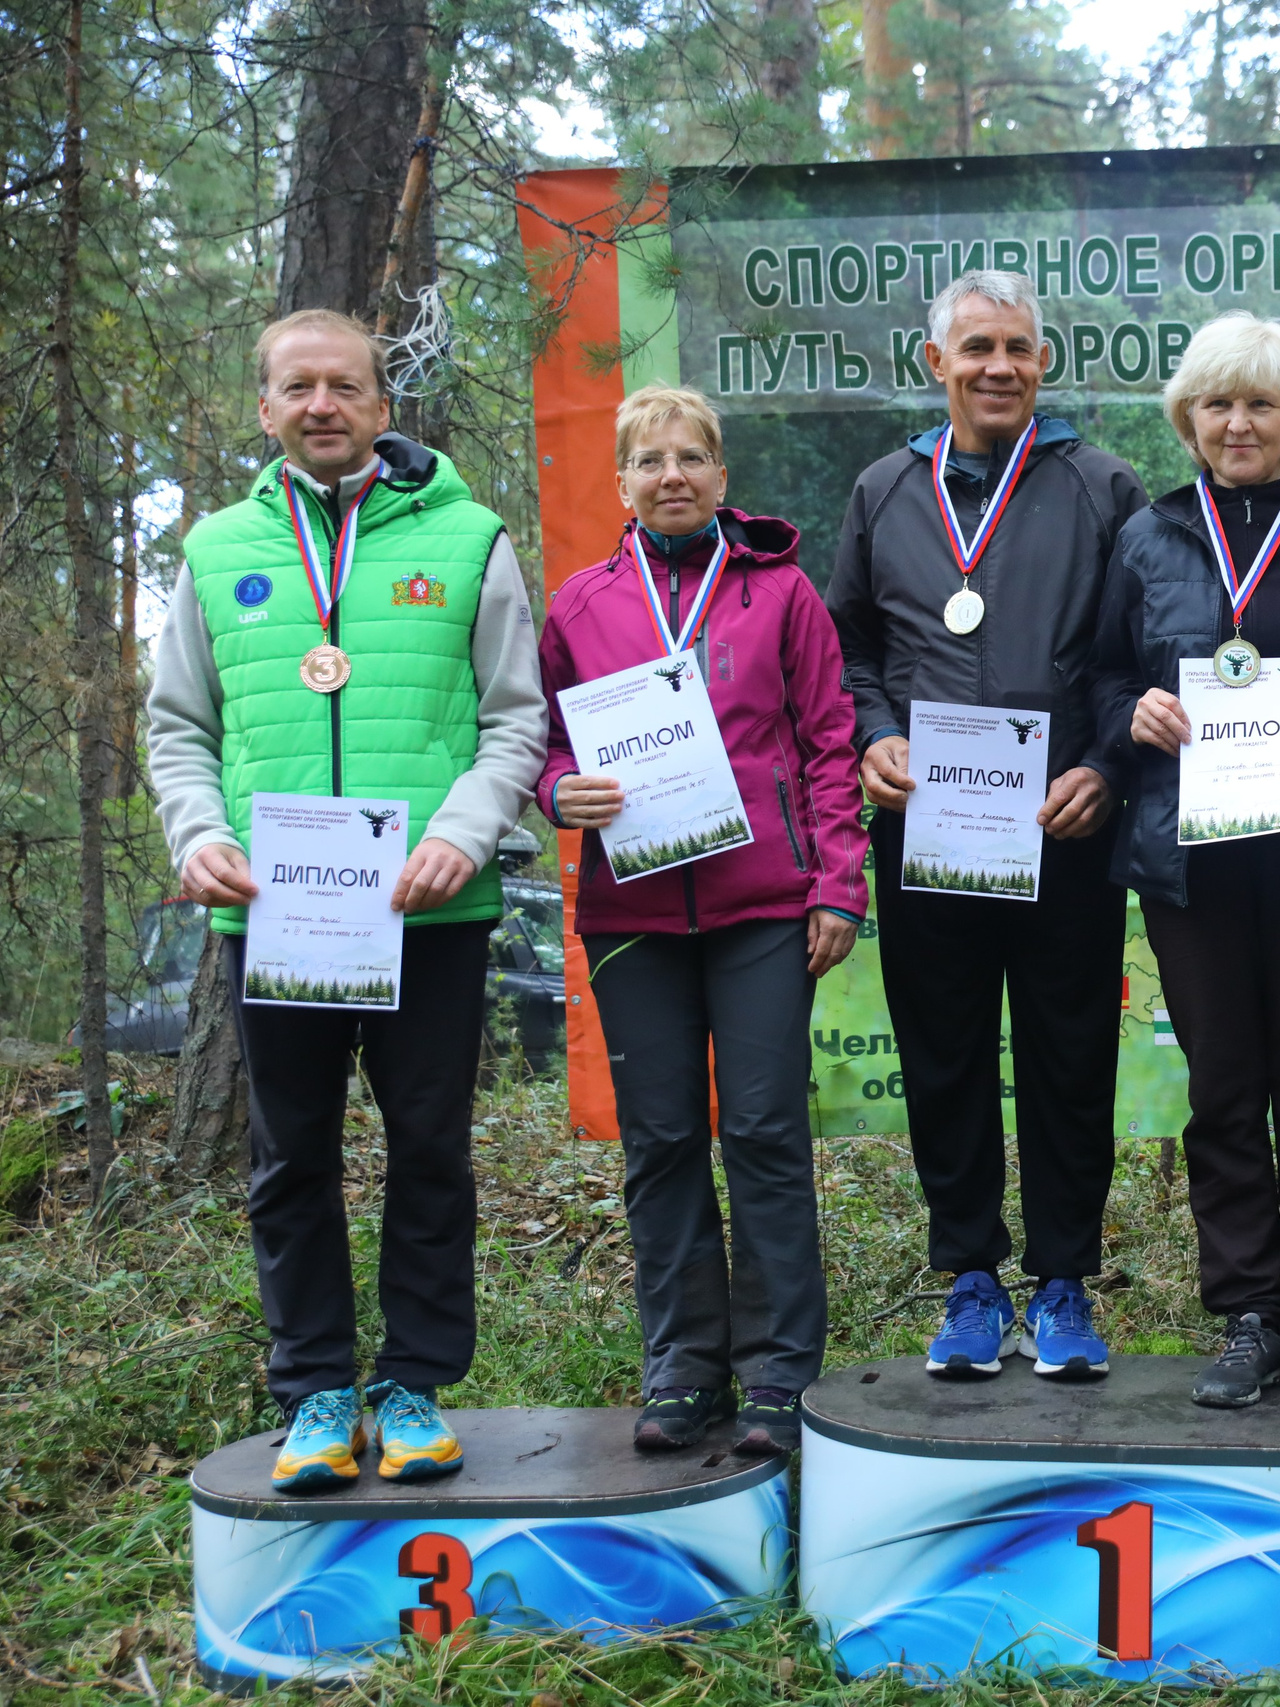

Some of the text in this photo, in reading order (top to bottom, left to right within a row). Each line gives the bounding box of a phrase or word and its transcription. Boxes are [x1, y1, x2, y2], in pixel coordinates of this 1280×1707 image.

[745, 234, 1160, 308] СПОРТИВНОЕ
[718, 330, 872, 394] ПУТЬ
[892, 328, 928, 389] К
[315, 656, 337, 682] 3
[565, 676, 649, 707] ОТКРЫТЫЕ ОБЛАСТНЫЕ СОРЕВНОВАНИЯ
[577, 696, 608, 711] СПОРТИВНОМУ
[607, 684, 648, 701] ОРИЕНТИРОВАНИЮ
[925, 719, 956, 727] СПОРТИВНОМУ
[957, 722, 996, 731] ОРИЕНТИРОВАНИЮ
[966, 717, 1000, 725] СОРЕВНОВАНИЯ
[598, 720, 695, 767] ДИПЛОМ
[633, 751, 667, 765] НАГРАЖДАЕТСЯ
[927, 763, 1023, 790] ДИПЛОМ
[649, 792, 664, 801] МЕСТО
[671, 785, 687, 794] ГРУППЕ
[269, 813, 302, 821] СПОРТИВНОМУ
[303, 815, 348, 824] ОРИЕНТИРОВАНИЮ
[314, 809, 351, 817] СОРЕВНОВАНИЯ
[272, 864, 379, 889] ДИПЛОМ
[399, 1531, 477, 1650] 3
[1077, 1500, 1154, 1661] 1
